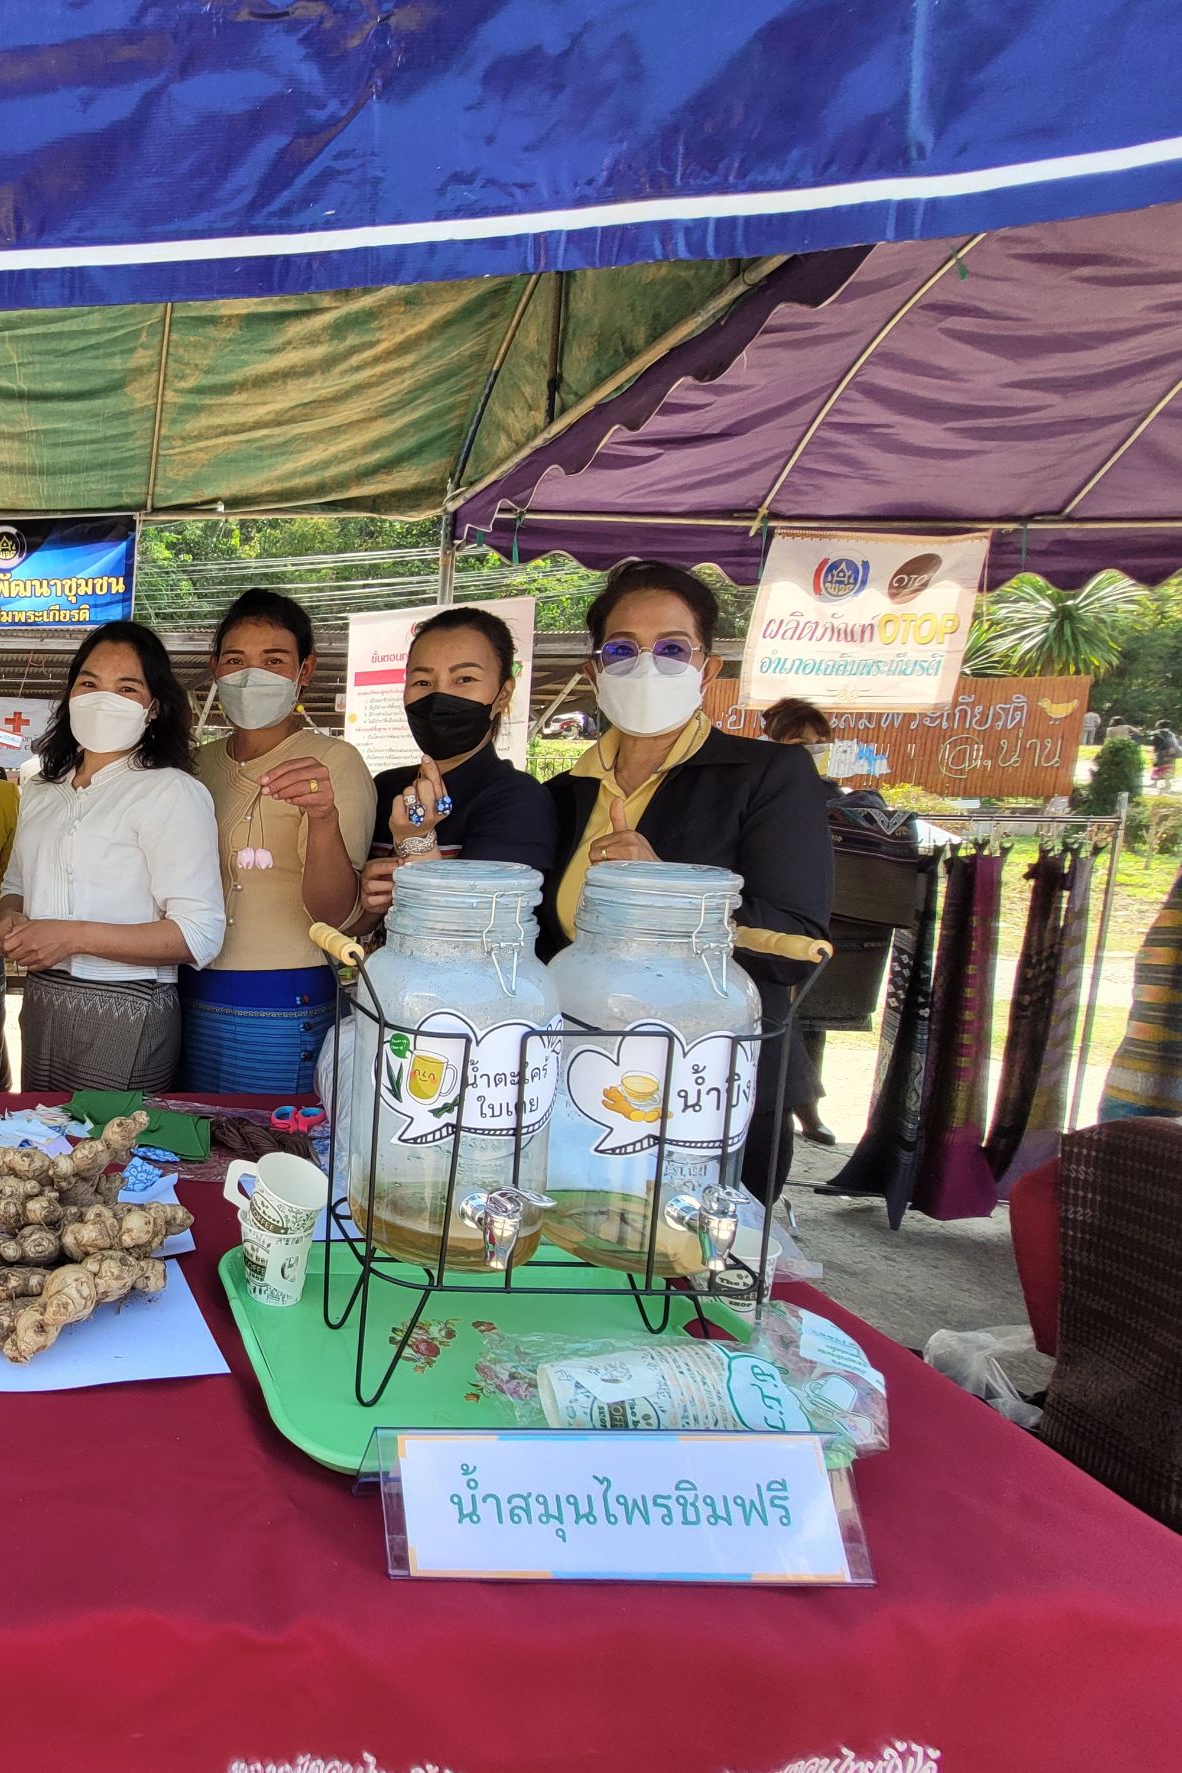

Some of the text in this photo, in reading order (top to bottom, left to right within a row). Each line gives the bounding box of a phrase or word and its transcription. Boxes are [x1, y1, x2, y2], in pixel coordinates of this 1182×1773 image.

[878, 612, 961, 645] OTOP
[759, 649, 944, 677] อำเภอเฉลิมพระเกียรติ
[997, 728, 1062, 768] น่าน
[449, 1462, 793, 1543] น้ำสมุนไพรชิมฟรี
